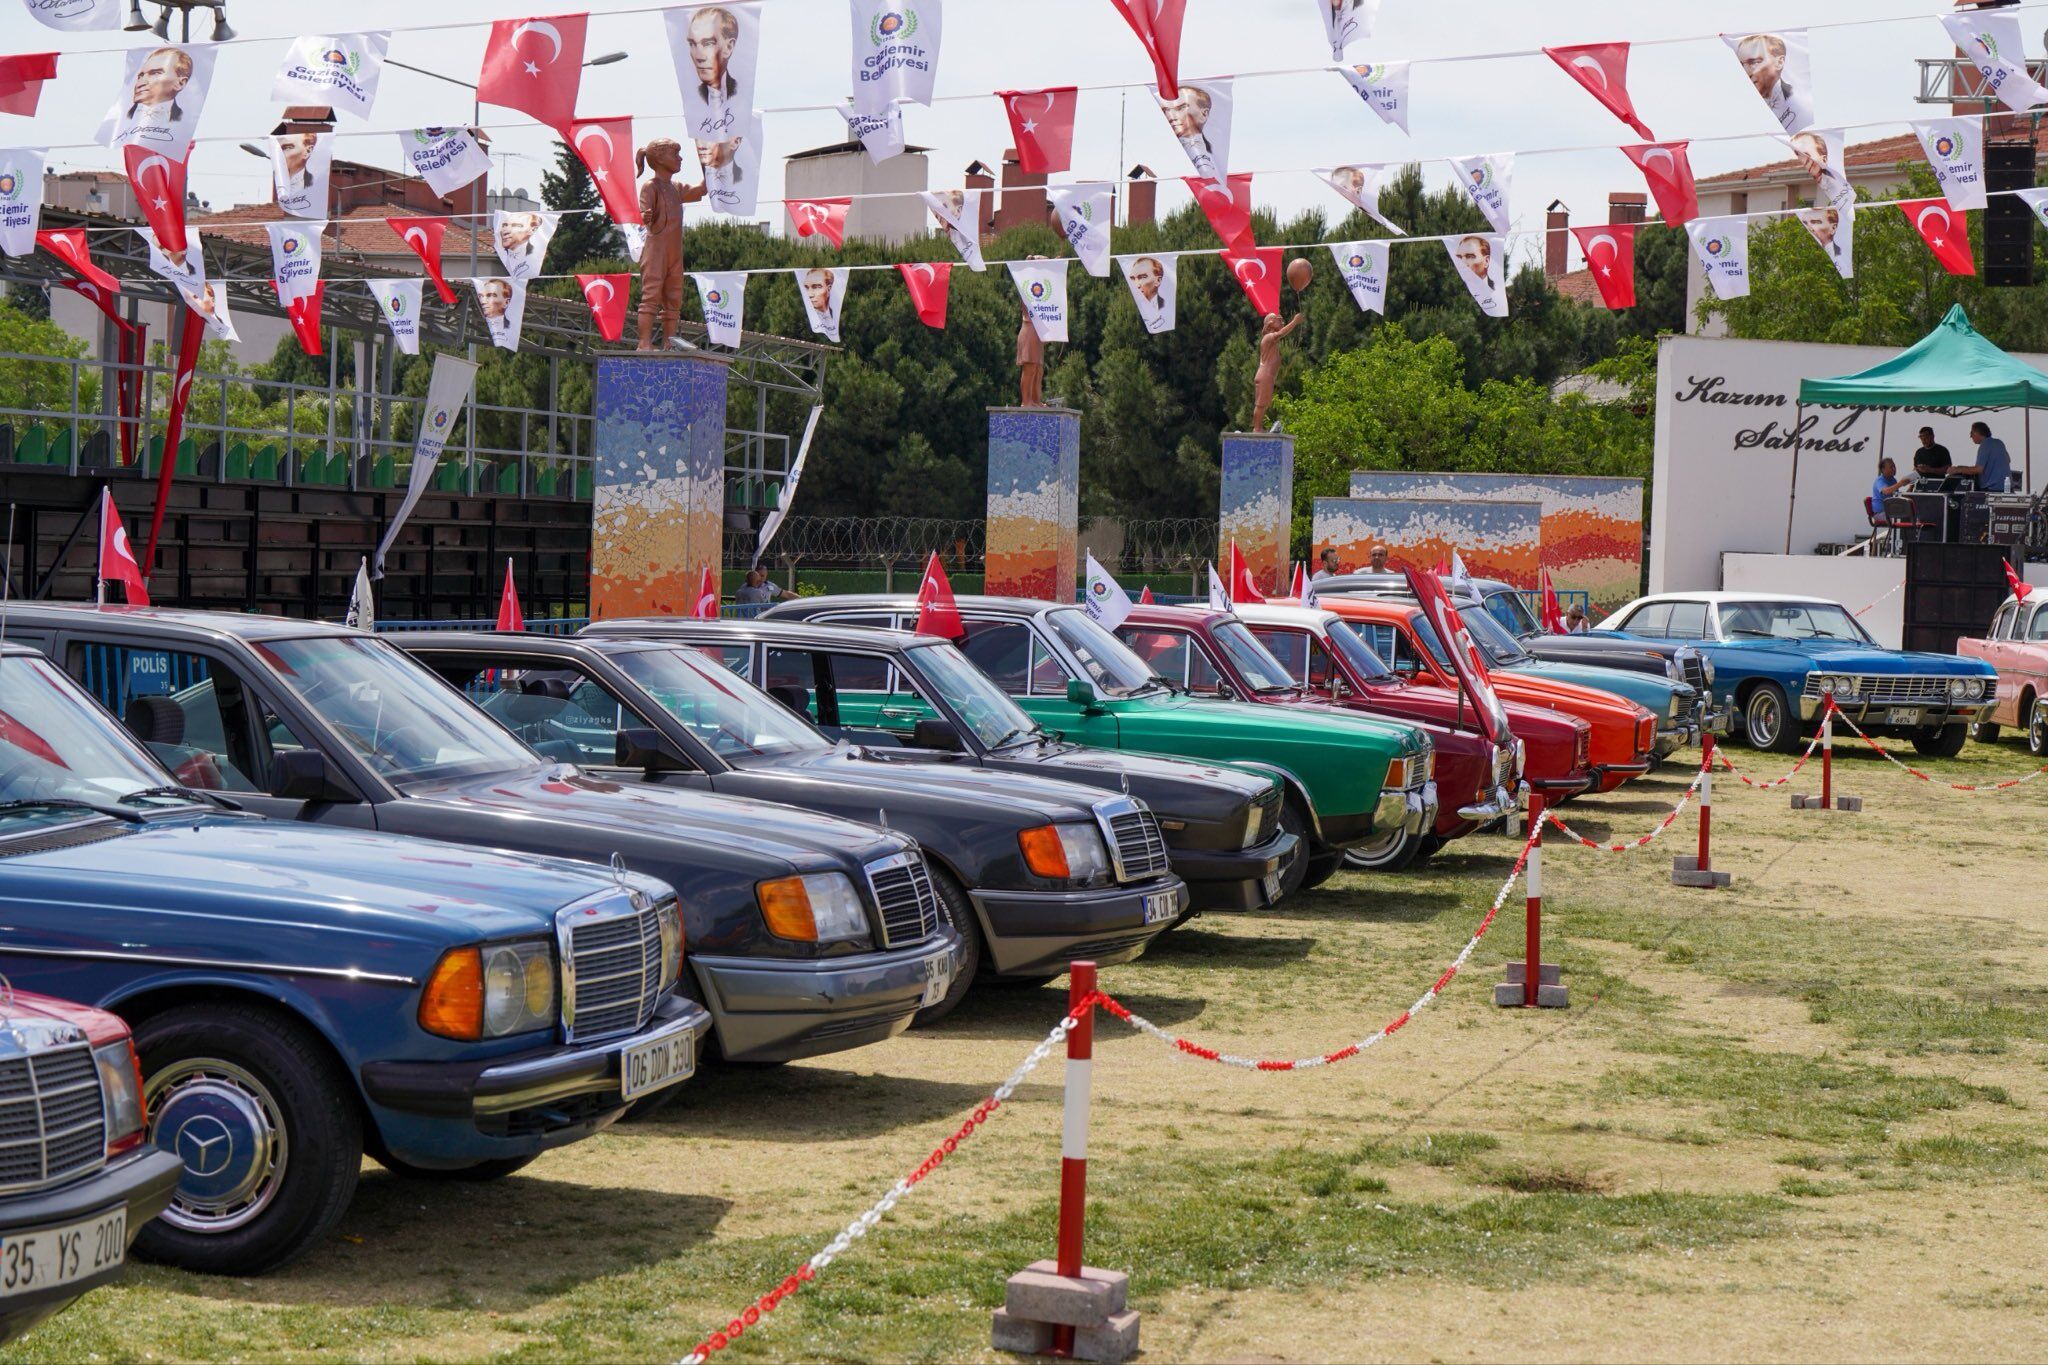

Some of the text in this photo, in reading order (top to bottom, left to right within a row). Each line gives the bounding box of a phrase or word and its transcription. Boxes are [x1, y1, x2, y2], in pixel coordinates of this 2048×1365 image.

[860, 56, 929, 82] Belediyesi
[864, 45, 926, 68] Gaziemir
[286, 70, 366, 102] Belediyesi
[295, 65, 364, 94] Gaziemir
[1675, 376, 1788, 407] Kazım
[1734, 415, 1870, 453] Sahnesi
[133, 653, 168, 674] POLİS
[632, 1053, 648, 1089] 06
[650, 1044, 670, 1081] DDN
[5, 1216, 124, 1289] 35 YS 200
